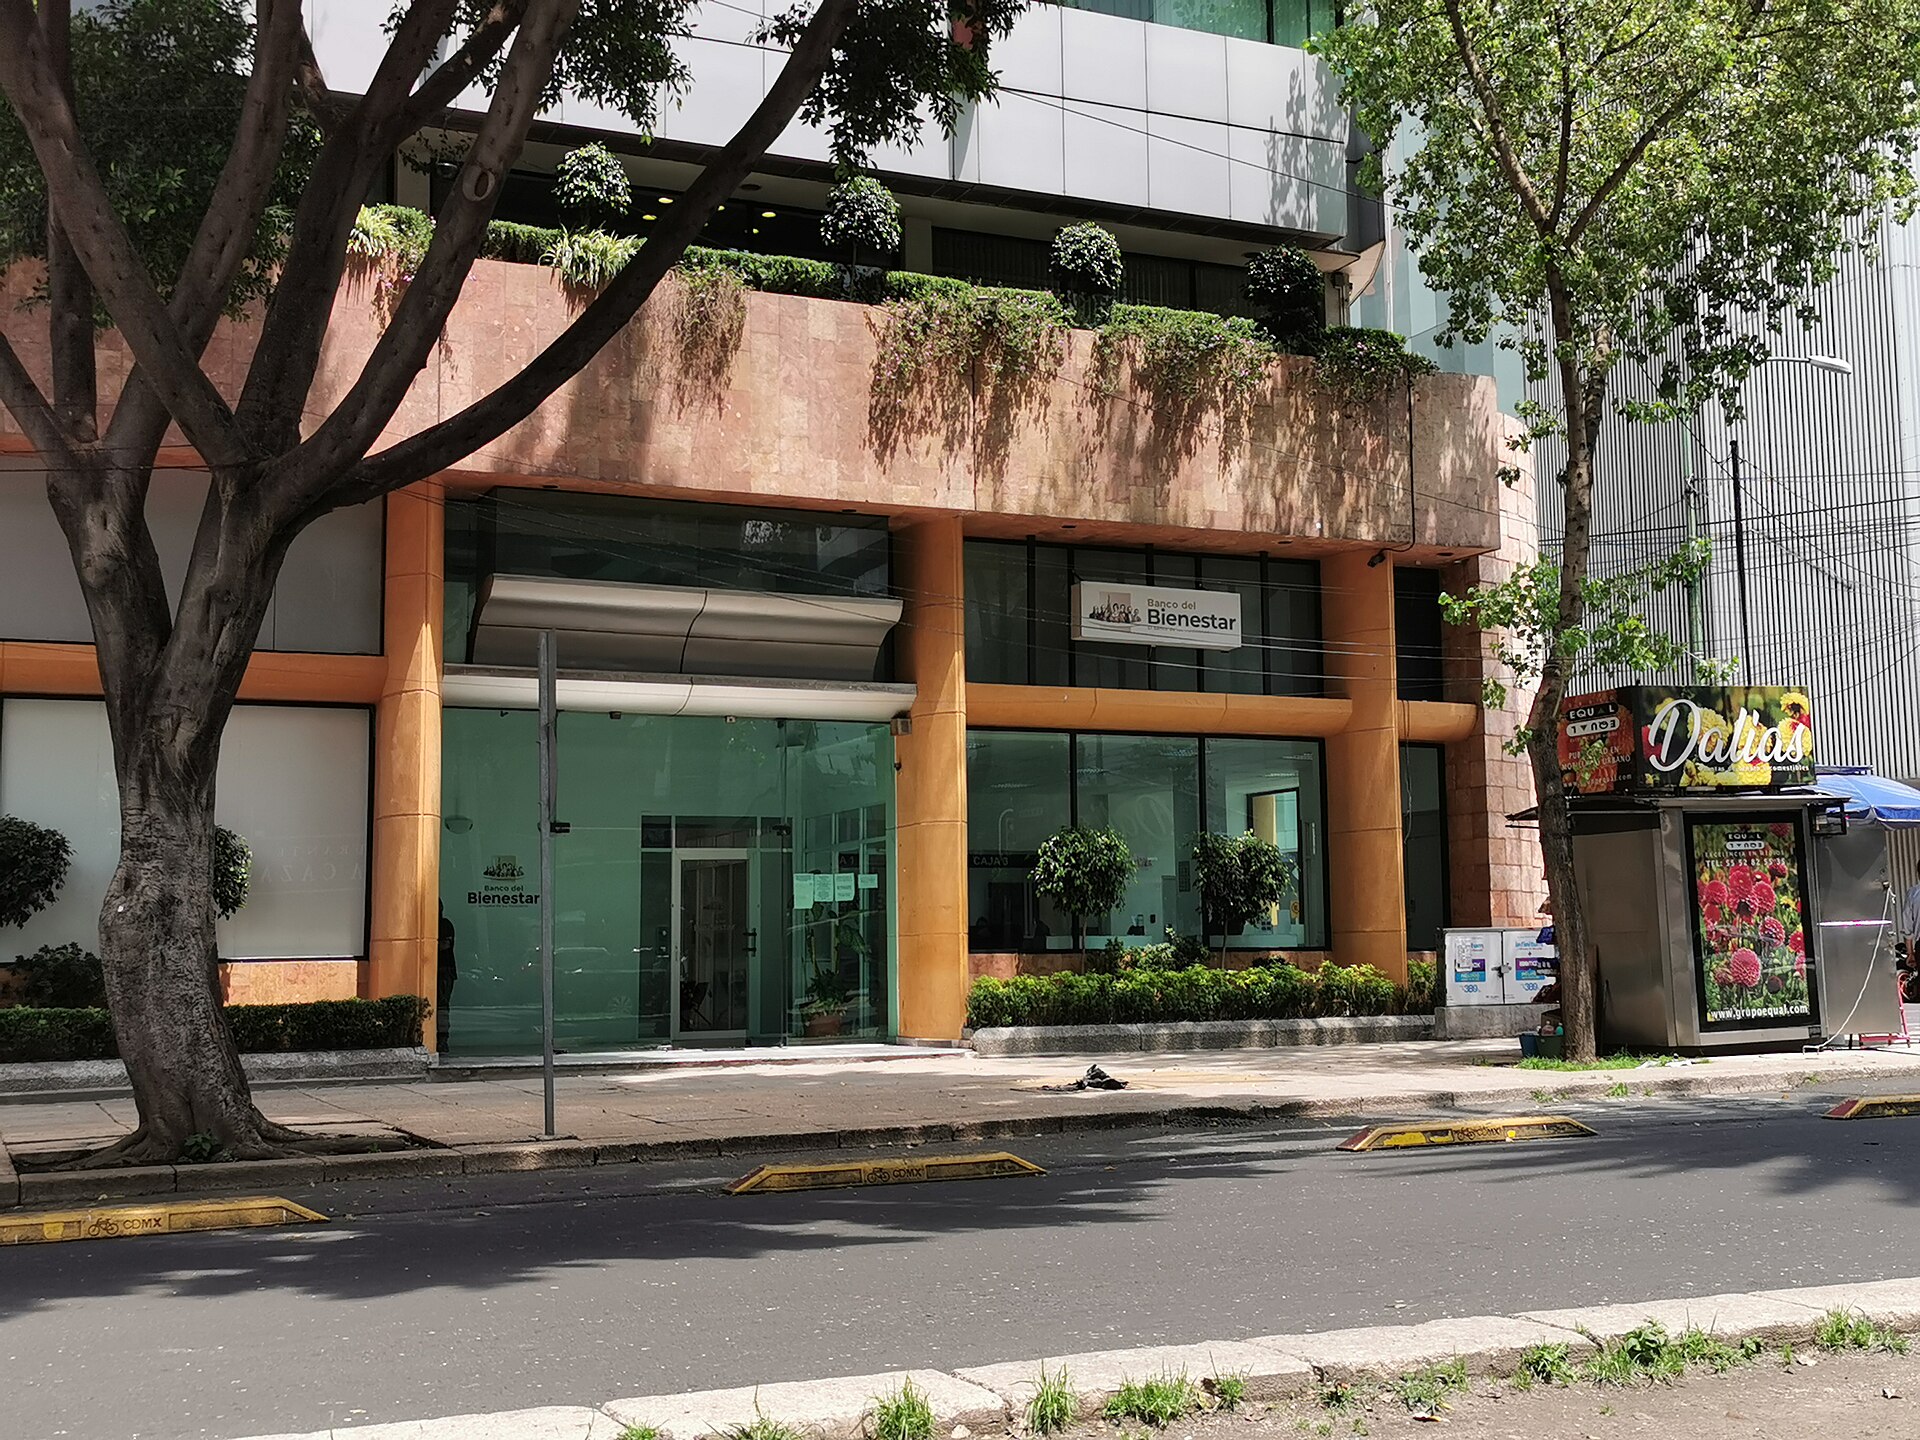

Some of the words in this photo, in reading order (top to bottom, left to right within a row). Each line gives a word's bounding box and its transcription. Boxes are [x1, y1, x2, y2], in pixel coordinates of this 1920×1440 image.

[1147, 598, 1178, 609] Banco
[1181, 601, 1197, 610] del
[1147, 608, 1237, 630] Bienestar
[1569, 704, 1615, 719] EQUAL
[1648, 698, 1806, 772] Dalias
[467, 891, 540, 905] Bienestar
[1711, 1004, 1809, 1020] www.grupoequal.com
[892, 1168, 922, 1178] CDMX
[122, 1217, 162, 1230] CDMX
